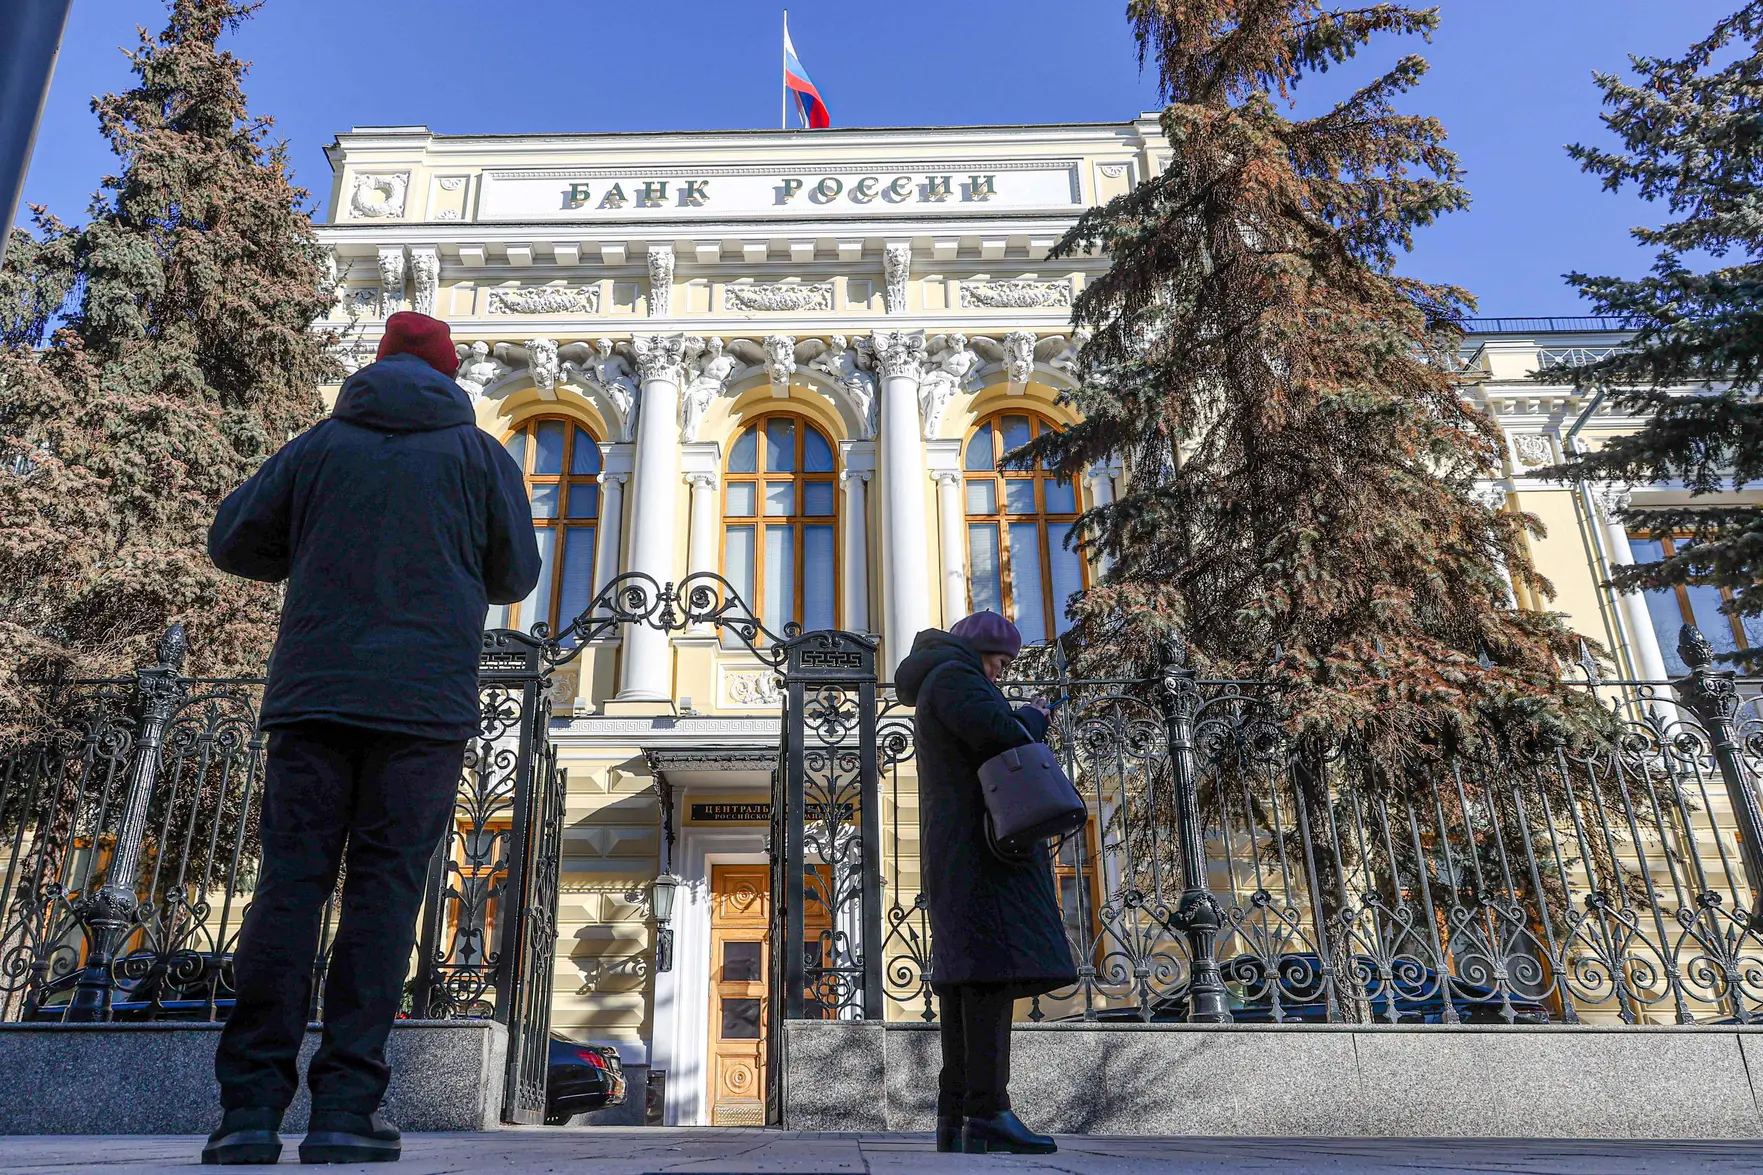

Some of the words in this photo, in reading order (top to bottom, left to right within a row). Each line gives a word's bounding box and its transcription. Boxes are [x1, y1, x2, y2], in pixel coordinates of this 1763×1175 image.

[568, 180, 711, 202] БАНК
[781, 175, 996, 198] РОССИИ
[705, 805, 770, 814] ЦЕНТРАЛЬ
